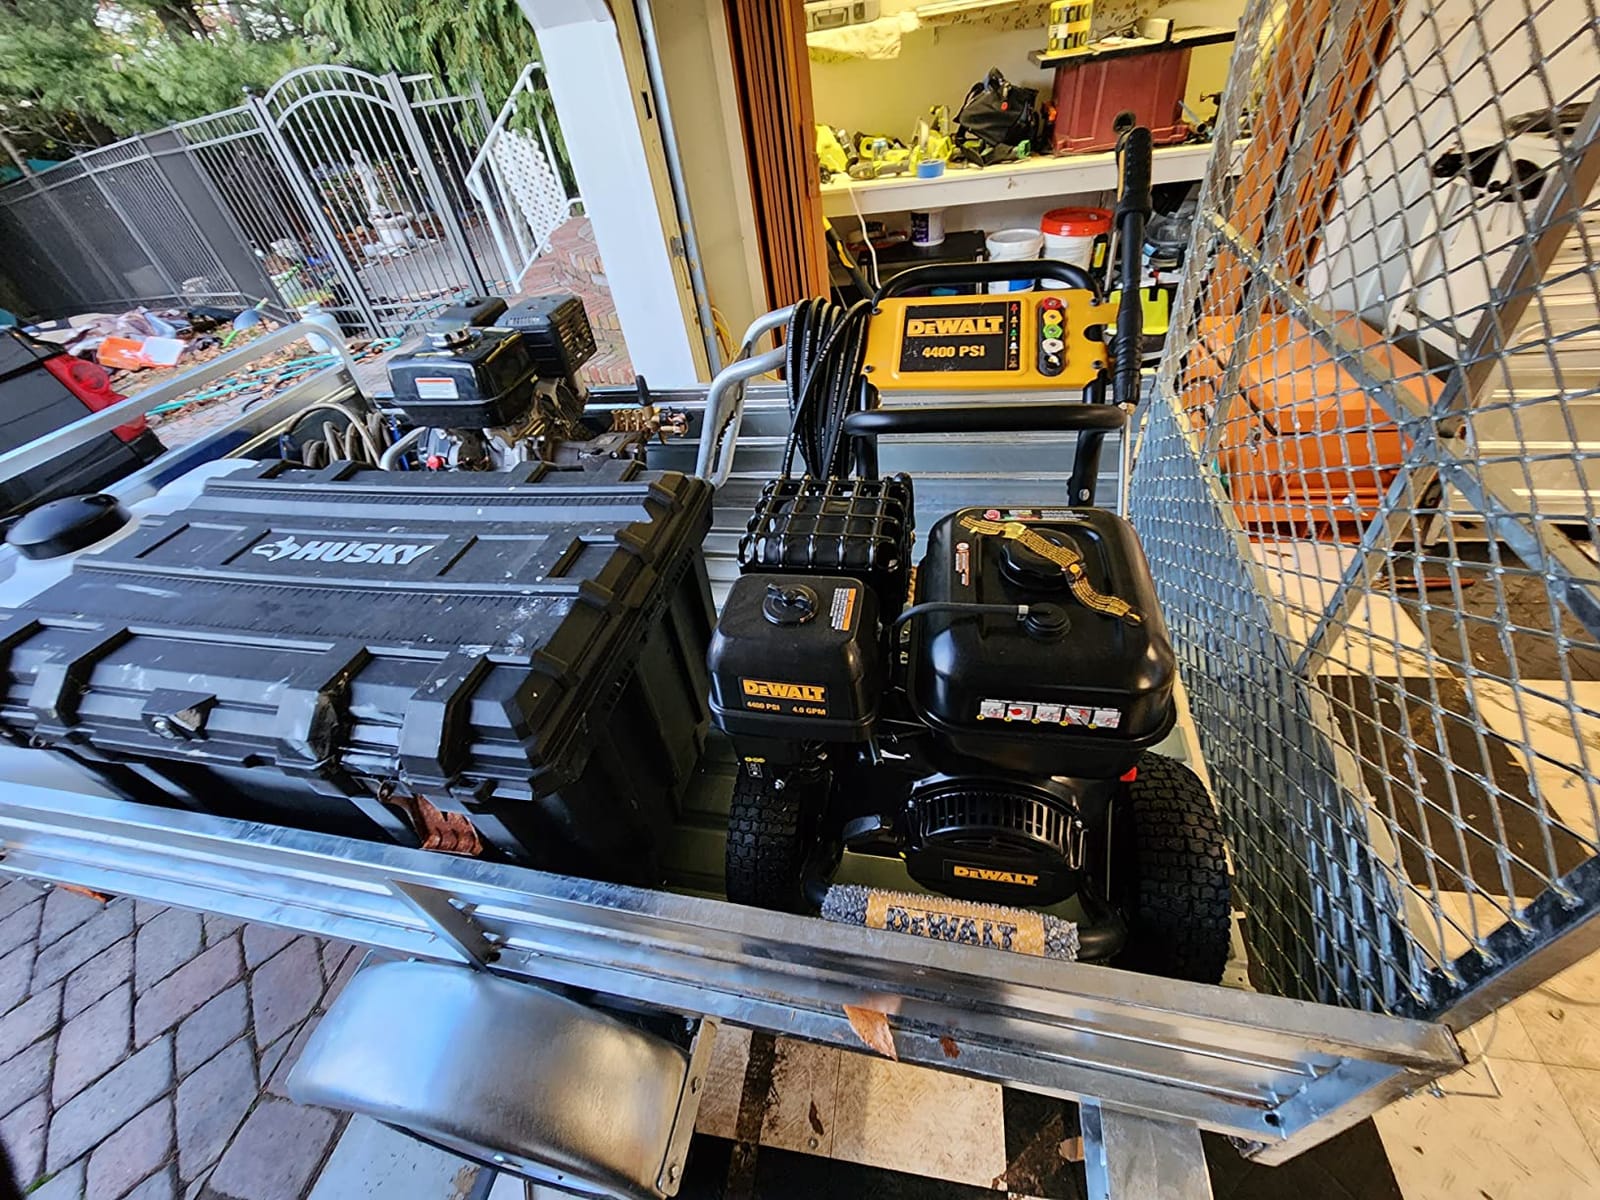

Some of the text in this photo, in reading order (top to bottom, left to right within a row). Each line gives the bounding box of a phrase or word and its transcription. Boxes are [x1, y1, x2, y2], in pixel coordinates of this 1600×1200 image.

[922, 345, 985, 358] 4400 PSI
[289, 540, 436, 565] HUSKY
[766, 703, 780, 711] PSI
[792, 705, 826, 716] 4.0 GPM
